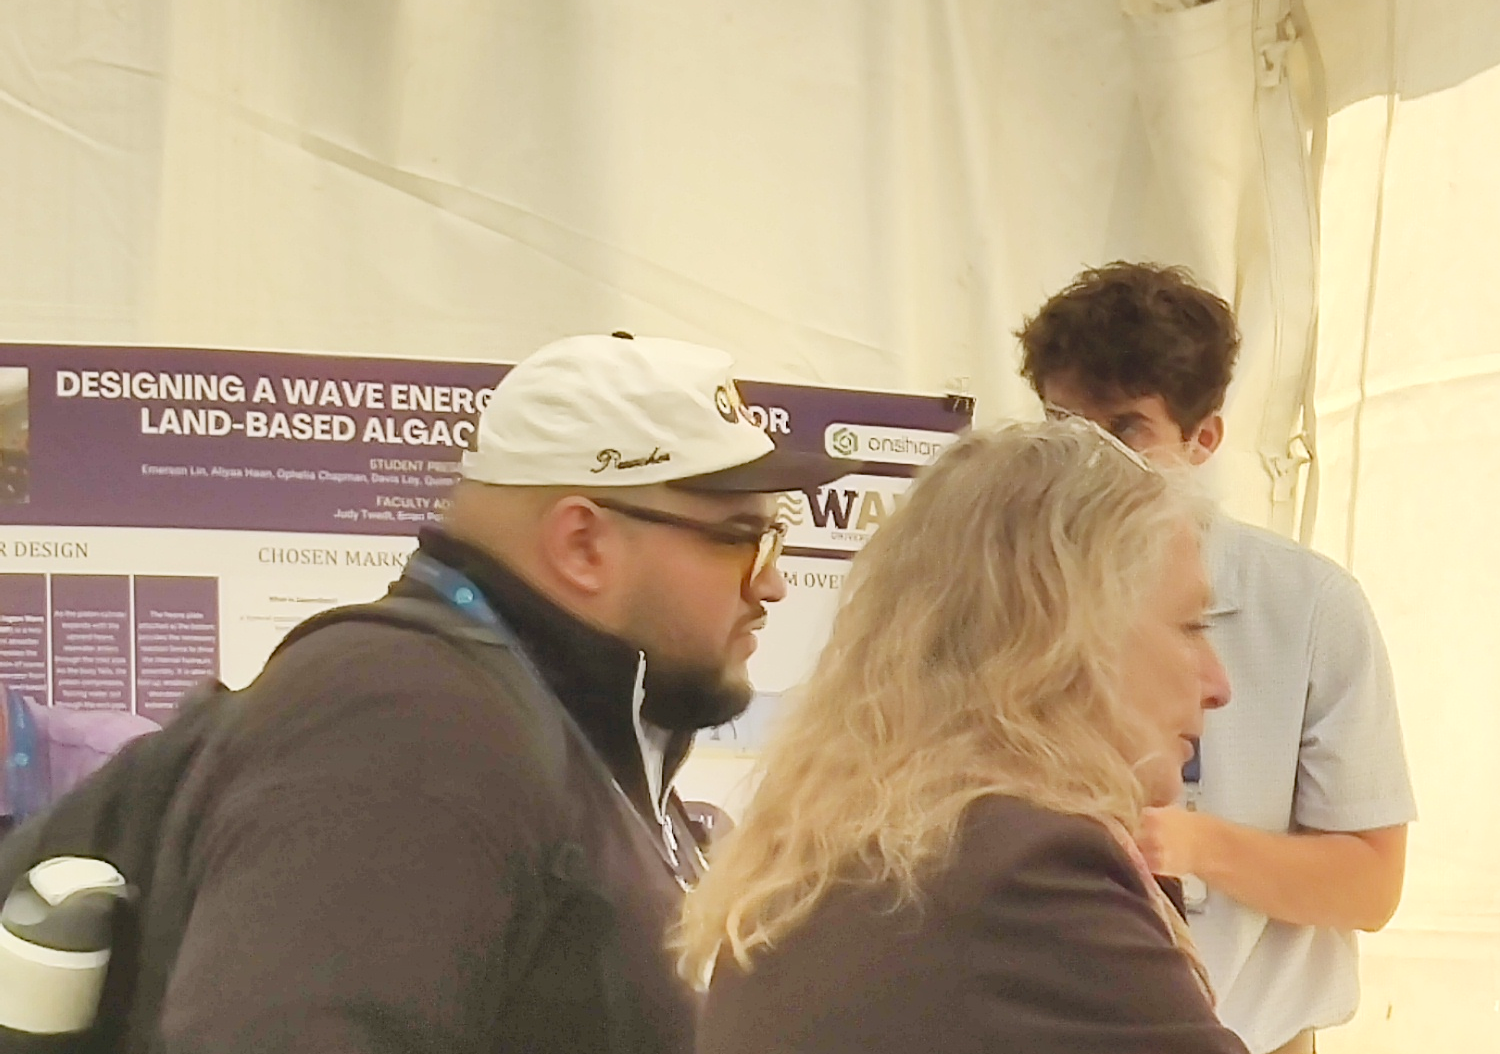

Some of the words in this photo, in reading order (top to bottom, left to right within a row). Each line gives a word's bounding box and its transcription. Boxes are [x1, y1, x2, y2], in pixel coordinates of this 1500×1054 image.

[56, 371, 246, 402] DESIGNING
[252, 377, 277, 404] A
[282, 378, 385, 409] WAVE
[141, 407, 356, 442] LAND-BASED
[370, 459, 423, 471] STUDENT
[376, 496, 430, 509] FACULTY
[14, 541, 88, 558] DESIGN
[258, 547, 338, 567] CHOSEN
